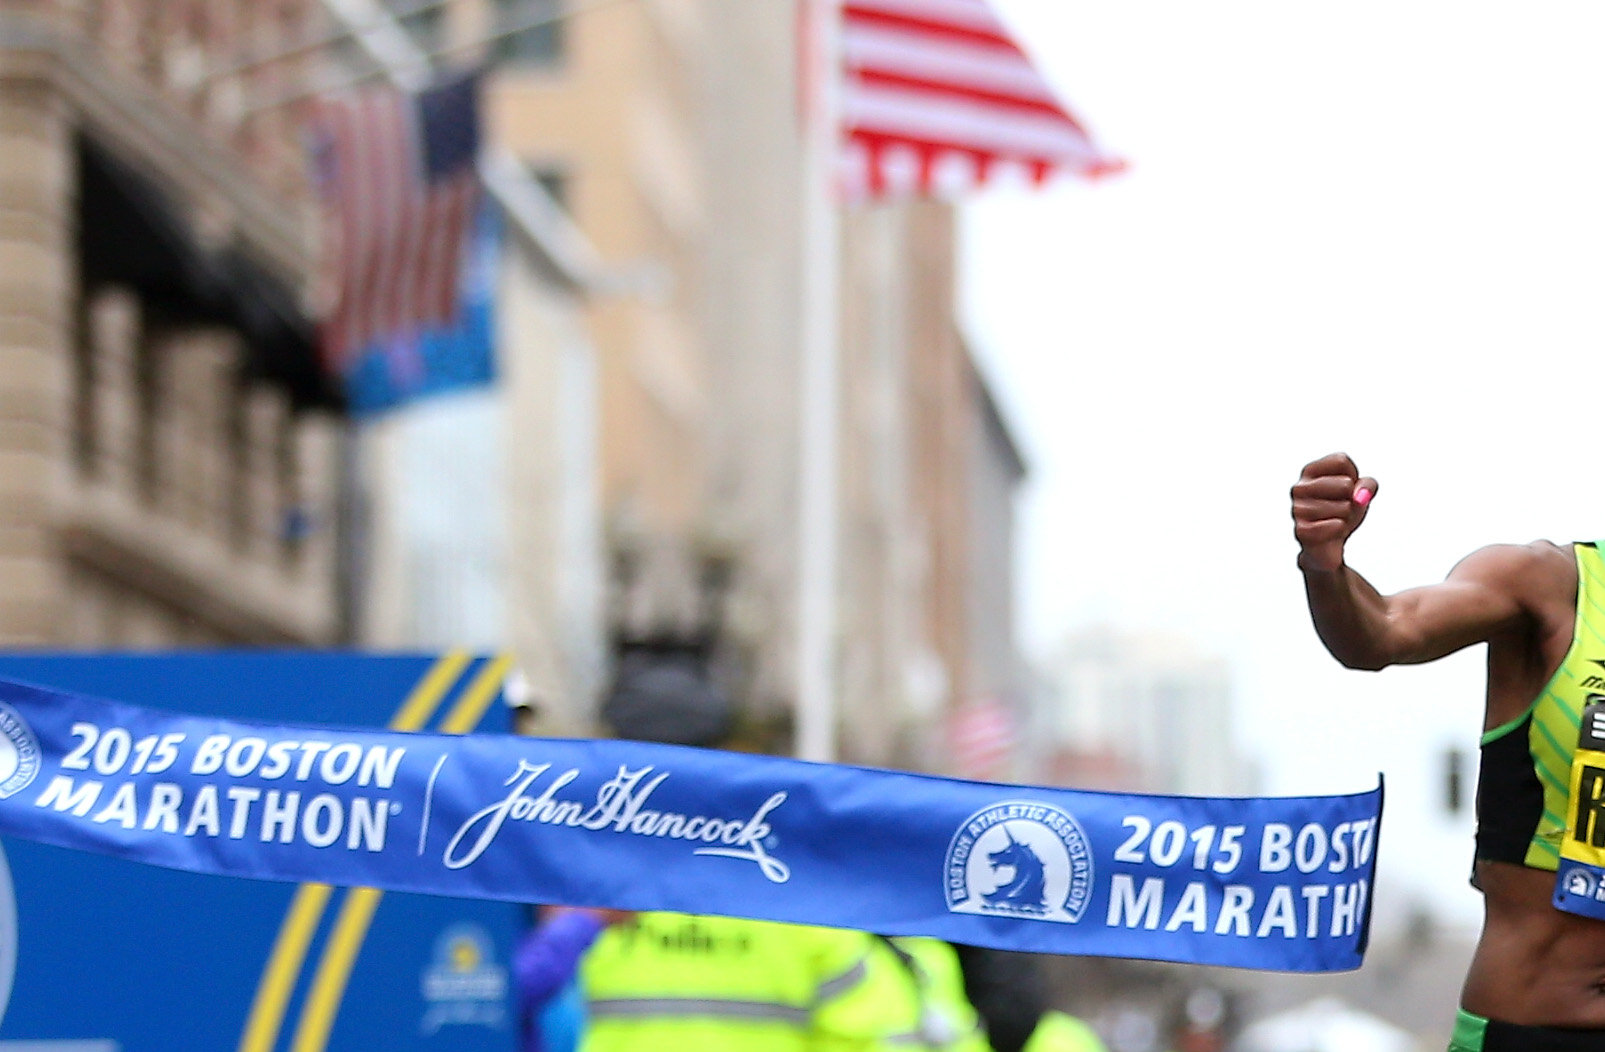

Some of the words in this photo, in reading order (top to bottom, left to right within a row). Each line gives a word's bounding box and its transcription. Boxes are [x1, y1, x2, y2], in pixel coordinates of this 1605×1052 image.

[60, 722, 186, 775] 2015
[190, 734, 406, 789] BOSTON
[34, 776, 390, 853] MARATHON
[581, 764, 791, 884] Hancock
[1113, 815, 1244, 874] 2015
[950, 836, 972, 902] BOSTON
[967, 805, 1045, 837] ATHLETIC
[1043, 812, 1088, 912] ASSOCIATION
